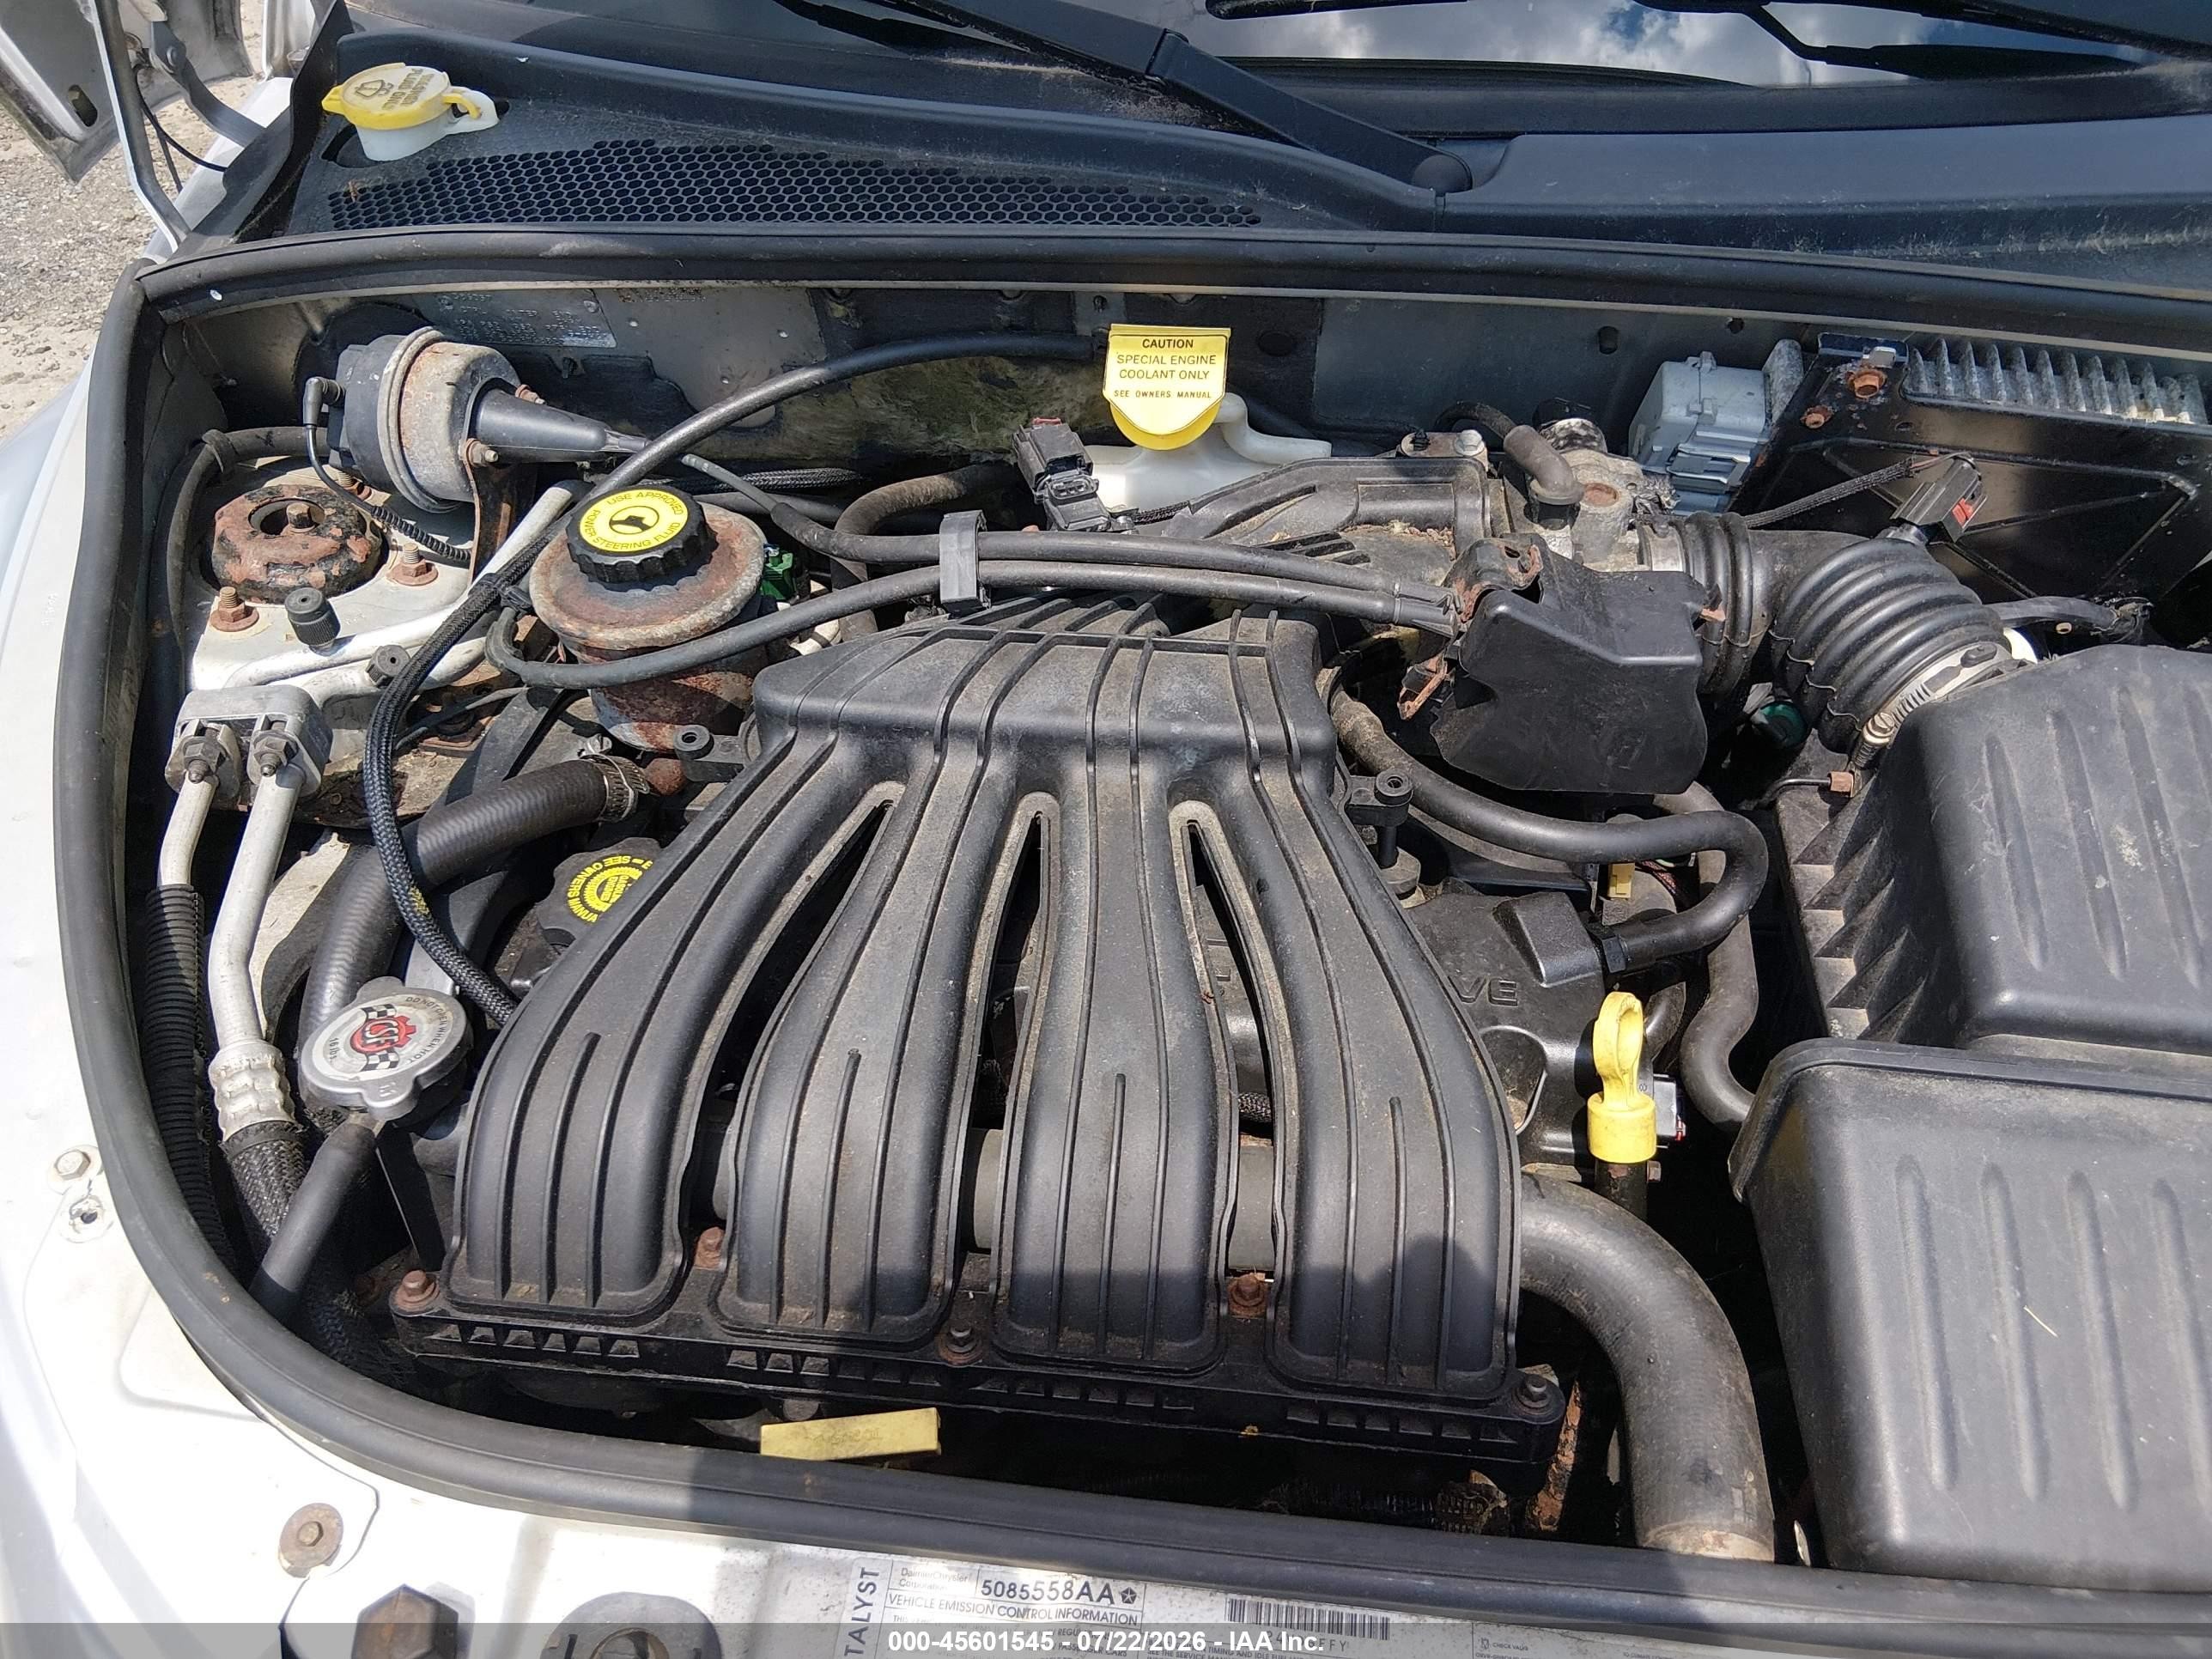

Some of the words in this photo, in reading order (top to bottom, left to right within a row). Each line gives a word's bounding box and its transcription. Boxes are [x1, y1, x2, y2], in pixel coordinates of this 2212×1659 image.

[1142, 338, 1194, 349] CAUTION
[1116, 354, 1167, 365] SPECIAL
[1170, 355, 1217, 365] ENGINE
[1119, 368, 1176, 380] COOLANT
[1178, 369, 1210, 380] ONLY
[1135, 390, 1171, 398] OWNERS
[606, 492, 632, 506] USE
[636, 491, 684, 515] APPROVED
[585, 509, 600, 537] POWER
[654, 522, 681, 543] FLUID
[592, 536, 652, 550] STEERING
[603, 855, 631, 866] SEE
[567, 862, 603, 897] OWNERS
[568, 897, 599, 922] MANUA
[421, 999, 441, 1009] NOT
[434, 1008, 447, 1025] OPEN
[365, 1019, 399, 1044] CSF
[427, 1026, 447, 1048] WHEN
[329, 1037, 339, 1047] 16
[406, 1047, 431, 1063] HOT
[981, 1579, 1115, 1605] 5085558AA
[844, 1566, 879, 1656] TALYST
[889, 1593, 935, 1608] VEHICLE
[939, 1598, 994, 1614] EMISSION
[997, 1605, 1053, 1620] CONTROL
[1054, 1607, 1138, 1626] INFORMATION
